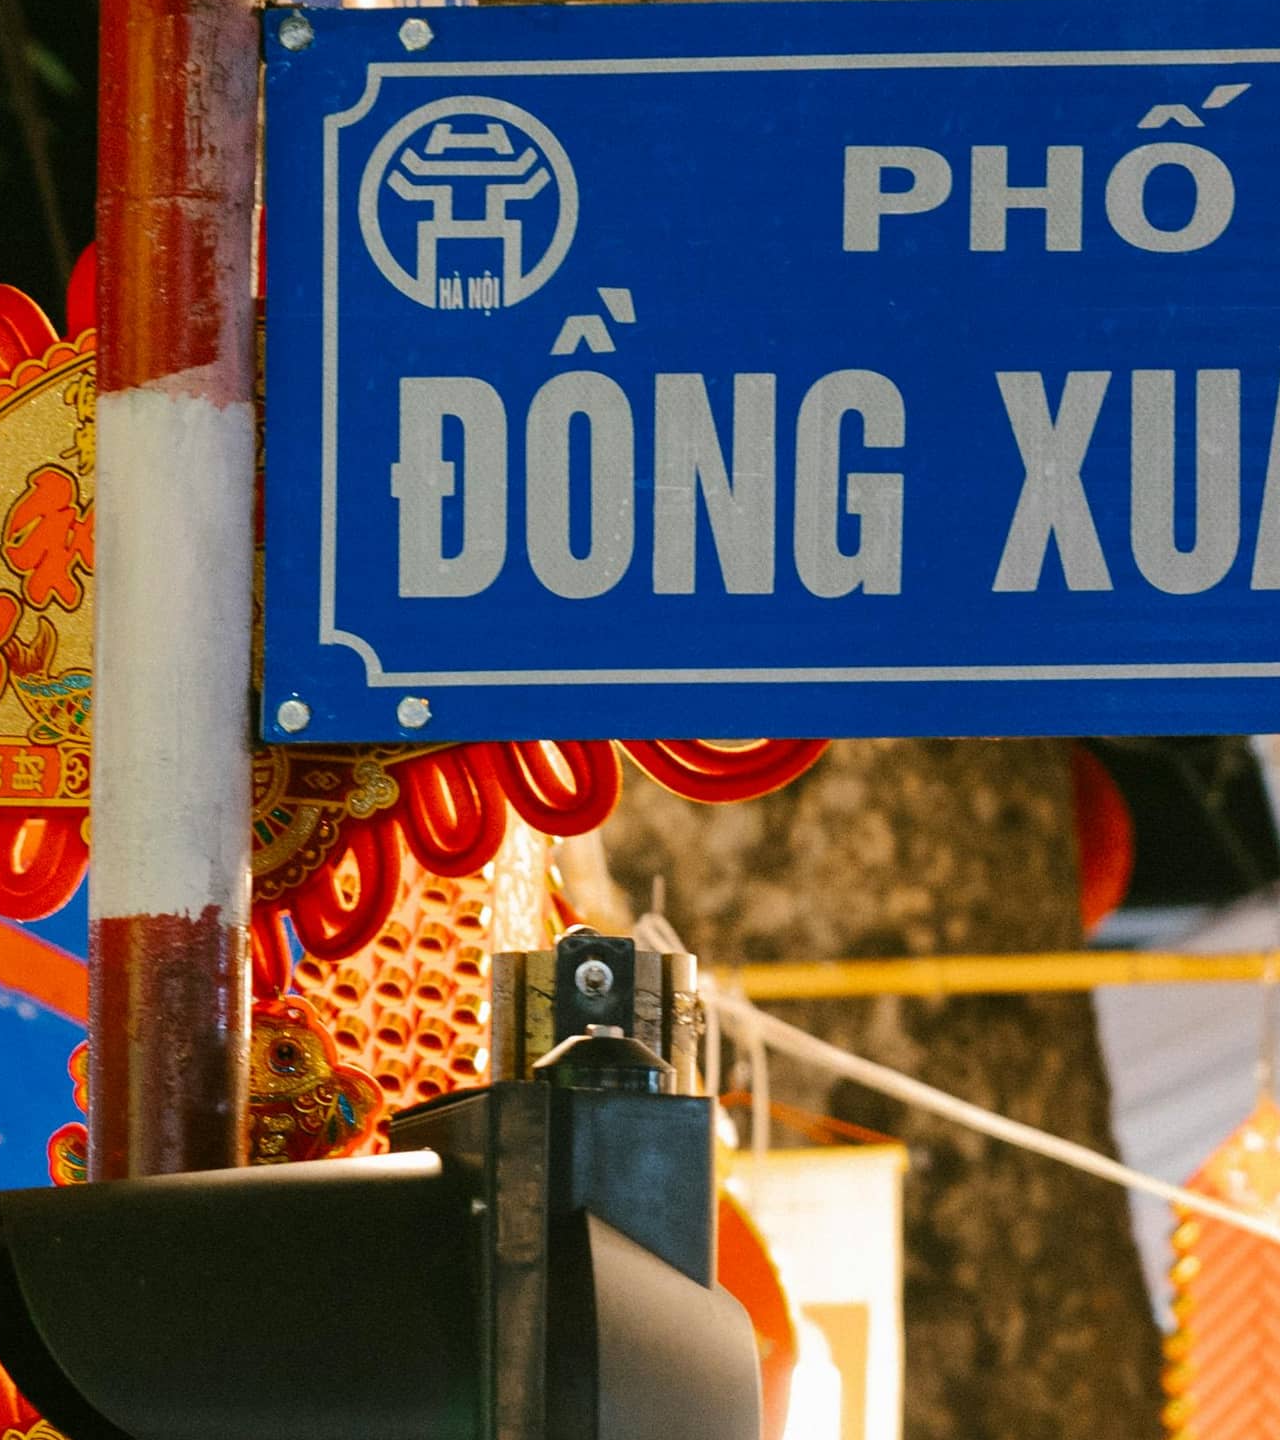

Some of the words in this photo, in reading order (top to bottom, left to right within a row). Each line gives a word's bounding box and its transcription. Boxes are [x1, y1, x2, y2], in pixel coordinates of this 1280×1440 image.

[841, 82, 1252, 253] PHỐ
[439, 270, 464, 310] HÀ
[468, 270, 500, 317] NỘI
[390, 286, 907, 599] ĐỒNG
